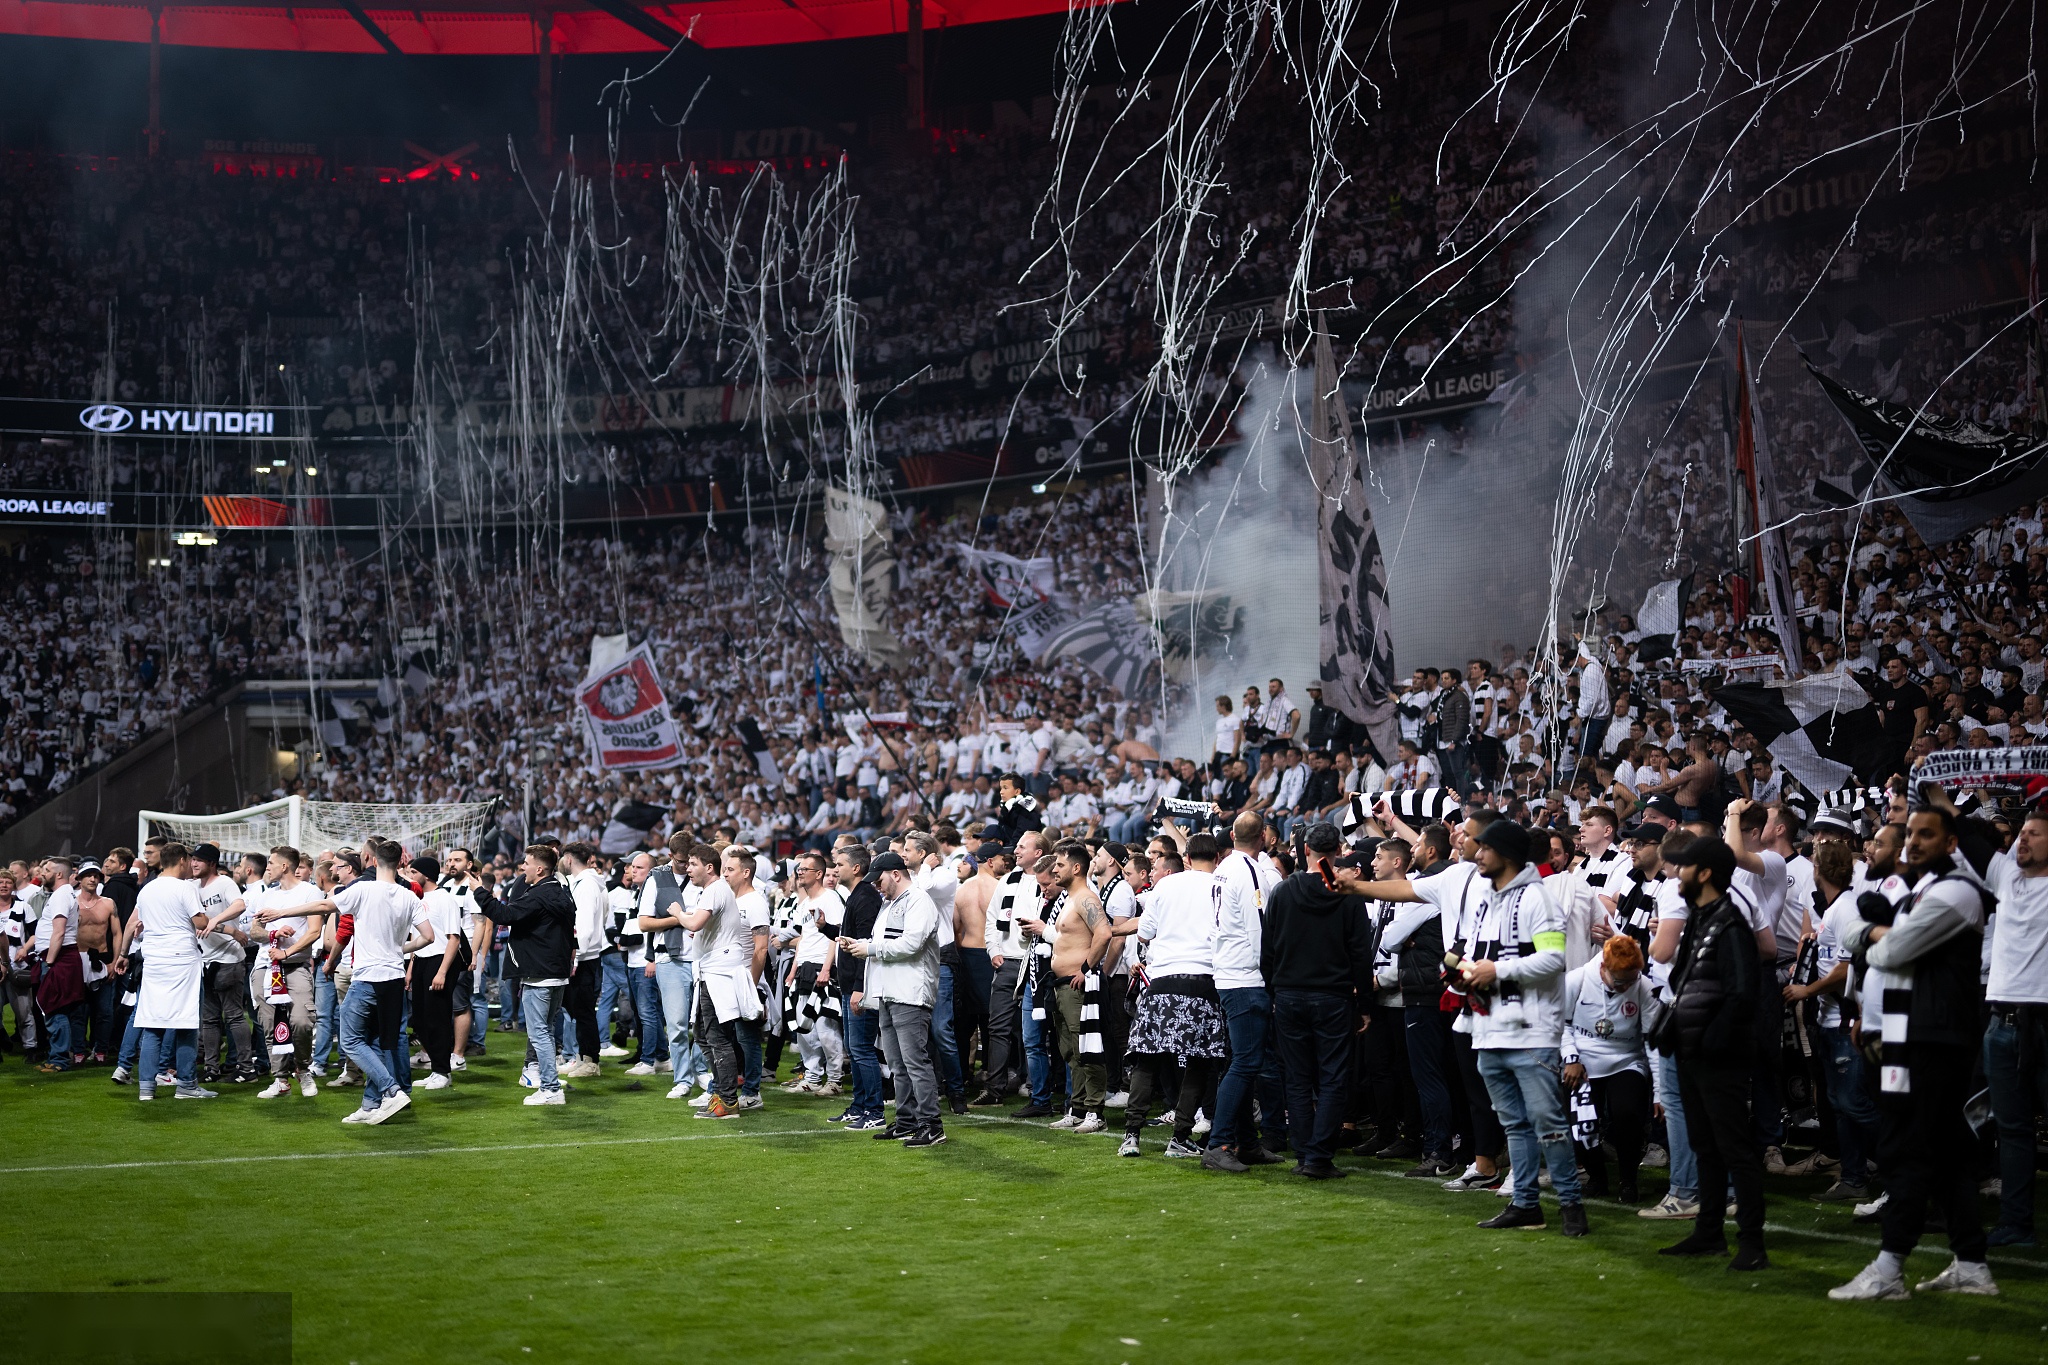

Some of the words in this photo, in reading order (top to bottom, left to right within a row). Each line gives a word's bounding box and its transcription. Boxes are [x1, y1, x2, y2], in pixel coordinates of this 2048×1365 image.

[1362, 383, 1431, 411] EUROPA
[1435, 369, 1505, 400] LEAGUE
[141, 409, 275, 434] HYUNDAI
[0, 498, 37, 514] ROPA
[43, 500, 107, 516] LEAGUE
[1986, 749, 2012, 761] 2:3
[1989, 759, 2011, 771] 1:1
